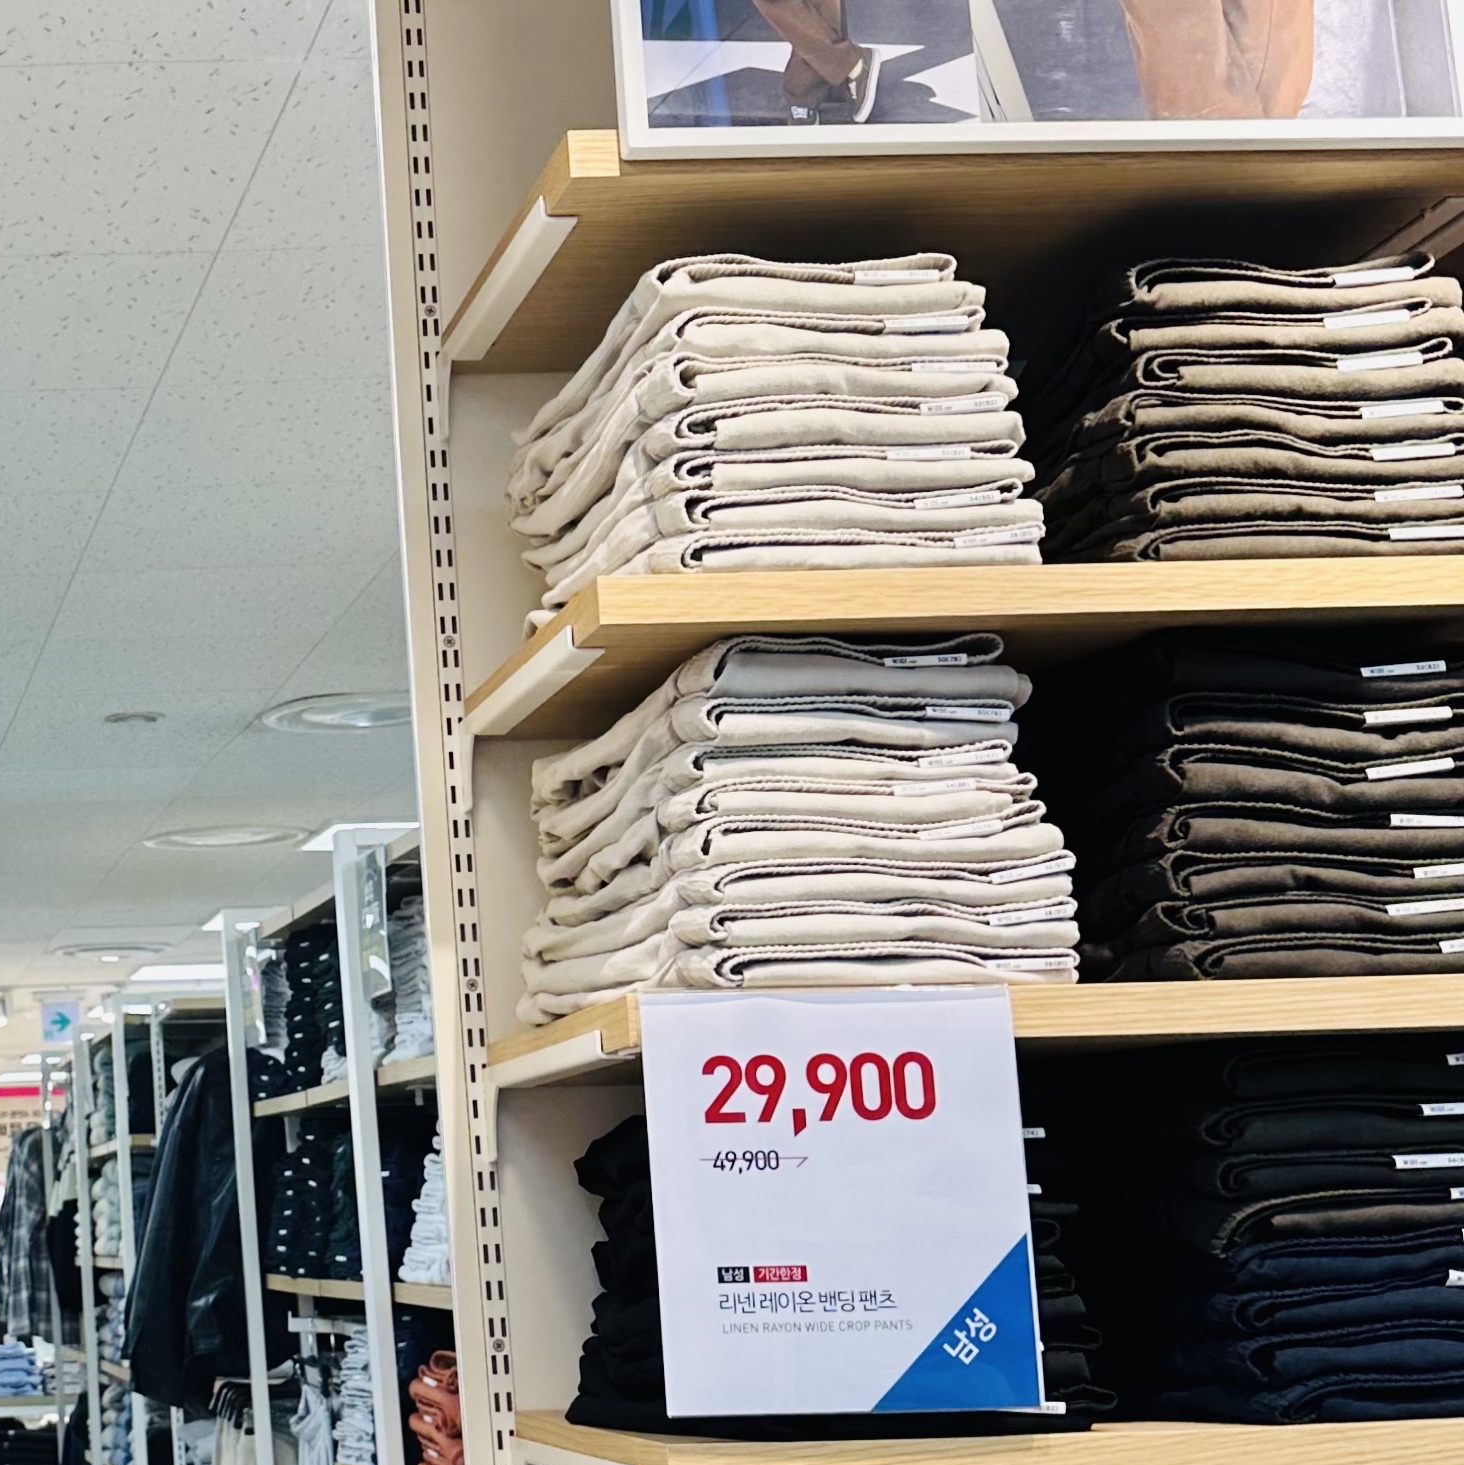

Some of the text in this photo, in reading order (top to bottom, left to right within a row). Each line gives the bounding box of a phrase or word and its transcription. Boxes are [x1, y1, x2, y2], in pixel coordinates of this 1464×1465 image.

[702, 1051, 936, 1137] 29,900
[713, 1150, 780, 1175] 49,900
[721, 1268, 745, 1282] 남성
[758, 1267, 802, 1281] 기간한정
[719, 1289, 898, 1314] 리넨 레이온 밴딩 팬츠
[722, 1319, 913, 1335] LINEN RAYON WIDE CROP PANTS
[942, 1307, 997, 1365] 남성
